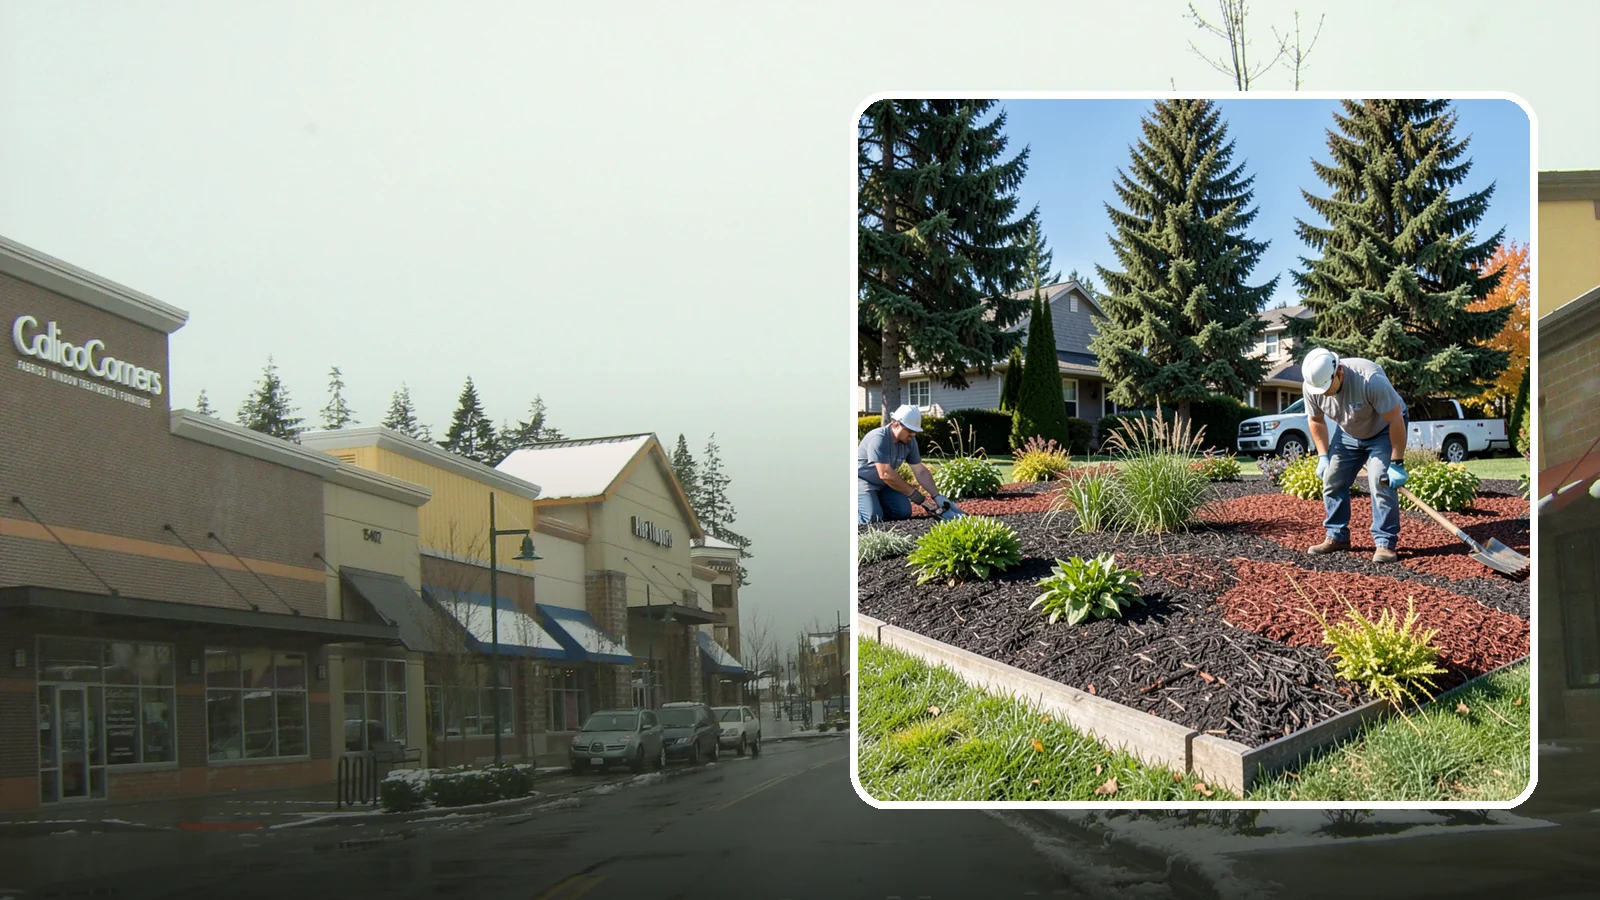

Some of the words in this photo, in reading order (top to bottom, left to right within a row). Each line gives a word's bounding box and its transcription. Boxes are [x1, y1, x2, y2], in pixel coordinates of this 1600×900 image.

[17, 360, 46, 377] FABRICS
[52, 370, 78, 386] WINDOW
[79, 378, 117, 399] TREATMENTS
[120, 391, 151, 409] FURNITURE
